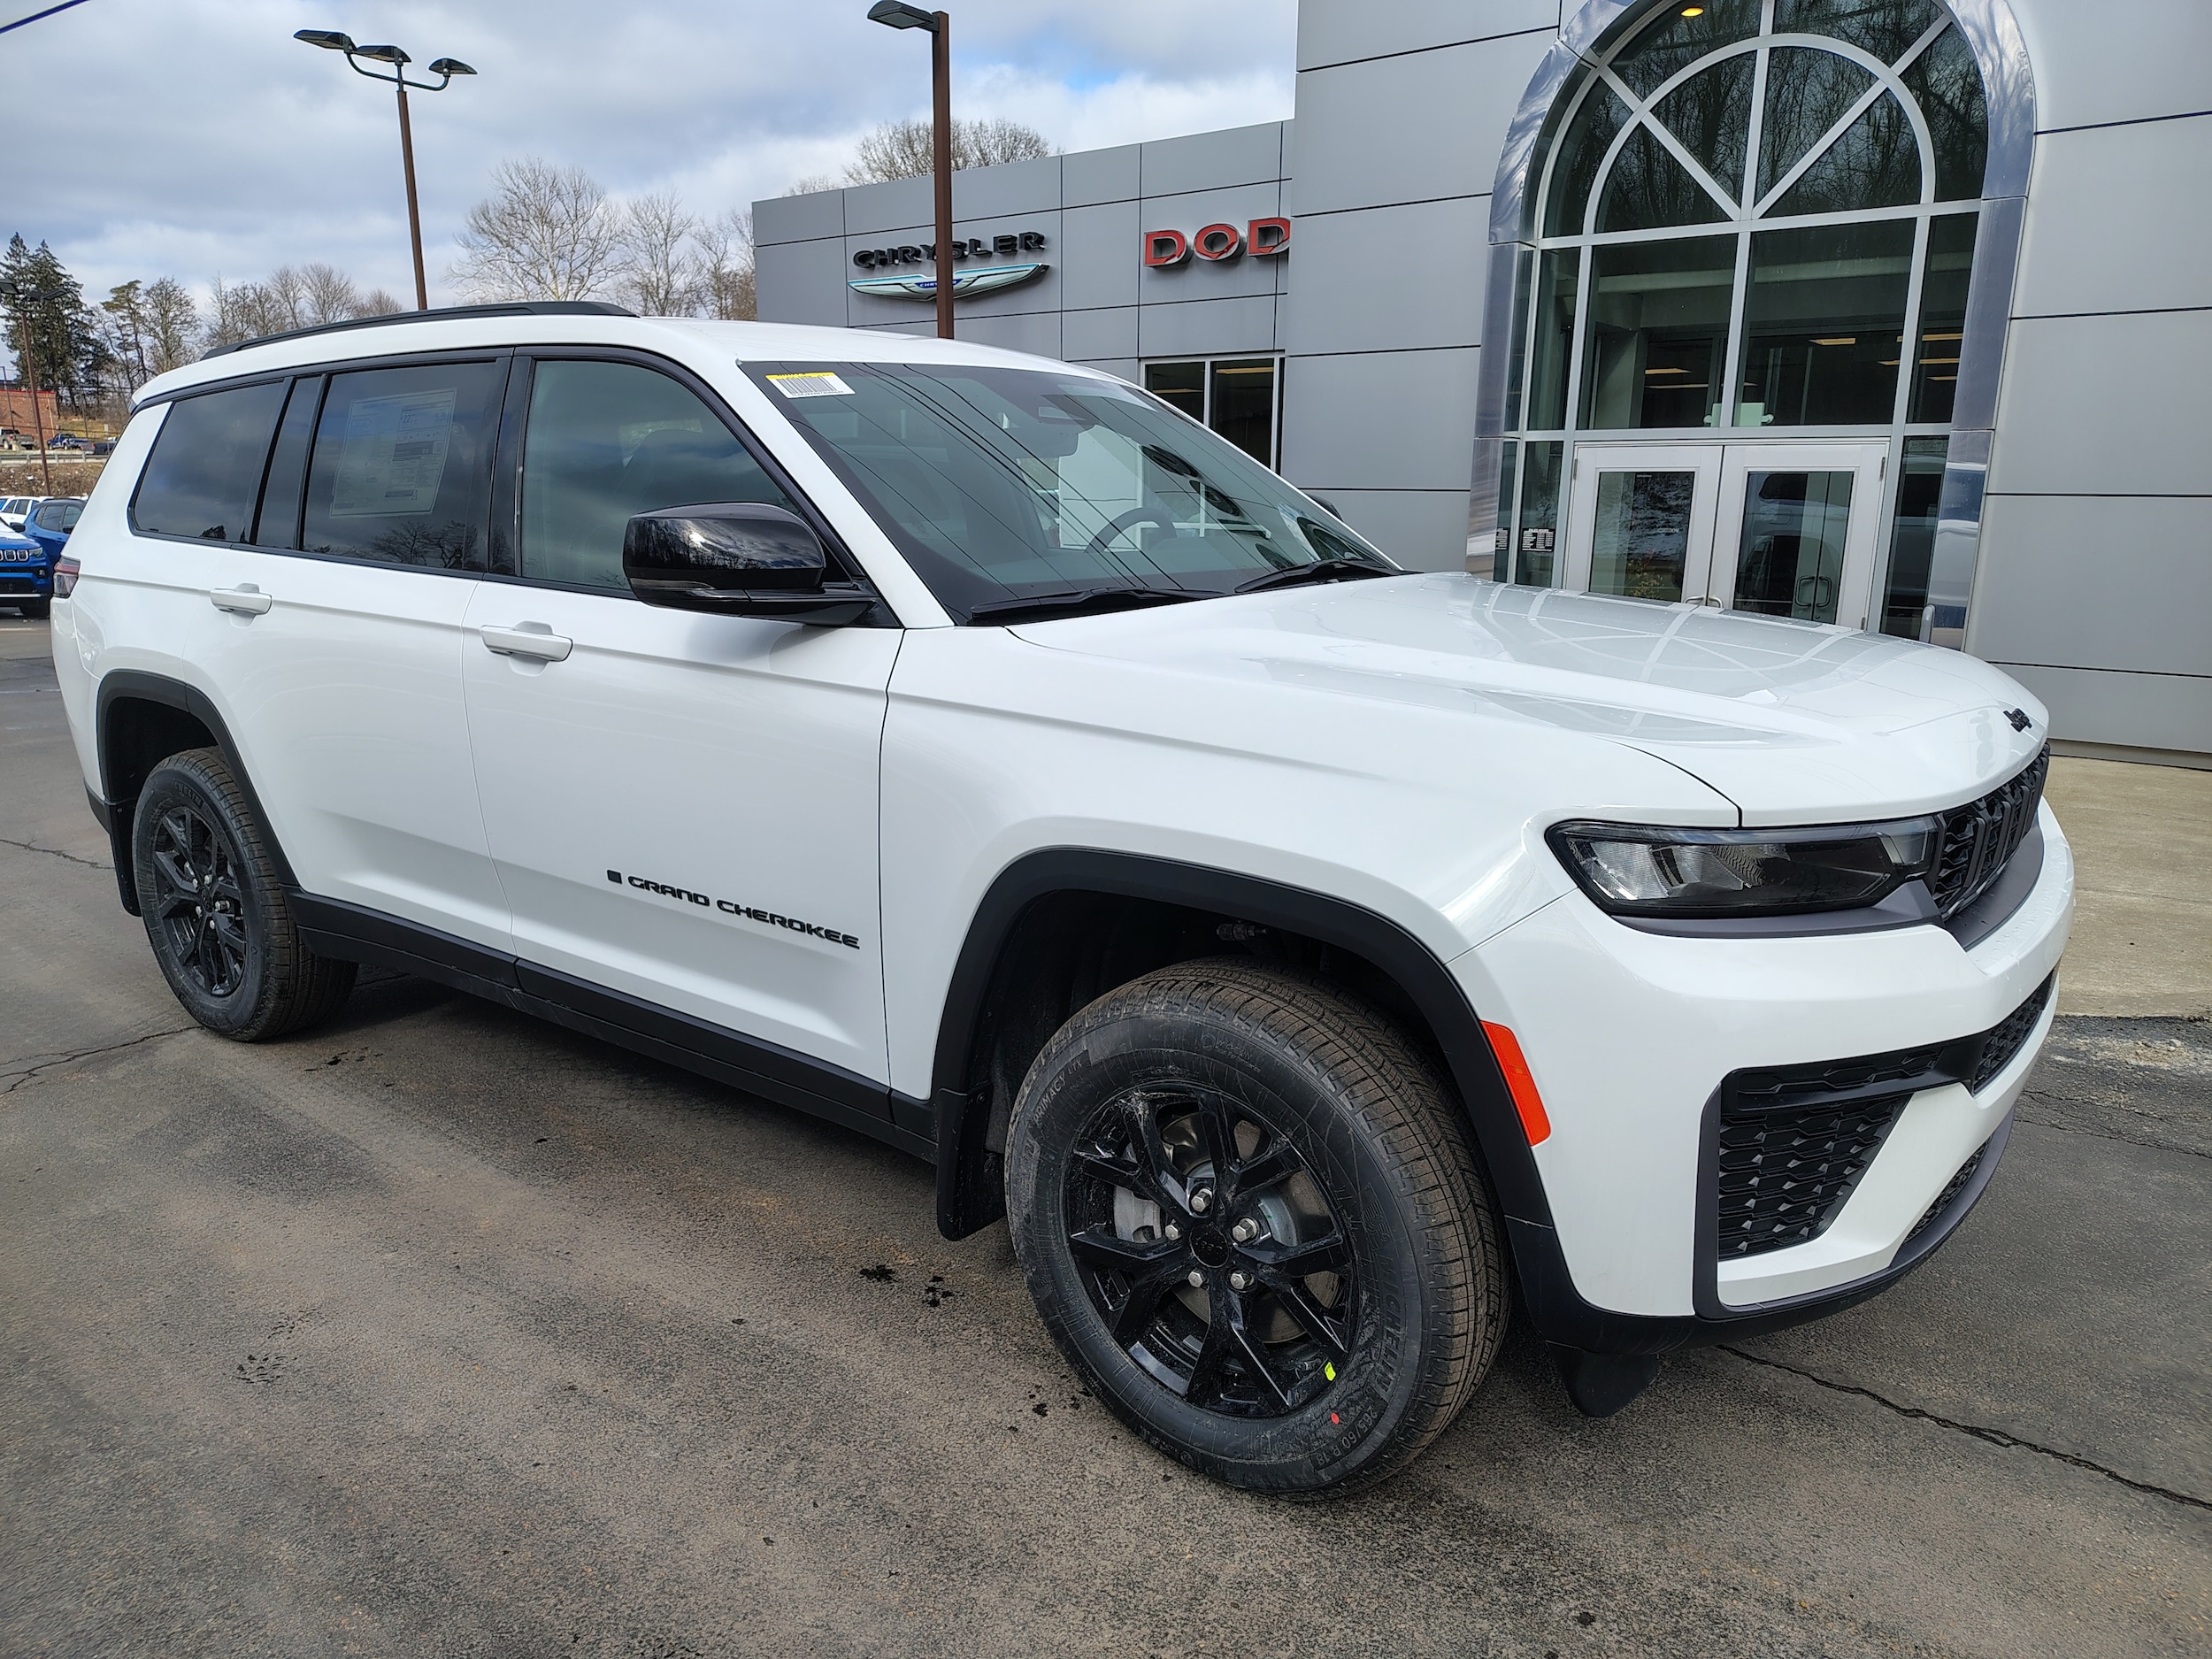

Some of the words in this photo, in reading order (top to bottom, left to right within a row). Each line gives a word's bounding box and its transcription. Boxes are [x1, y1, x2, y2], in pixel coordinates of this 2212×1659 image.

[627, 875, 710, 907] GRAND
[717, 899, 860, 949] CHEROKEE
[1033, 1071, 1066, 1127] PRIMACY
[1068, 1058, 1082, 1075] LTX
[1376, 1253, 1402, 1394] MICHELIN
[1341, 1405, 1378, 1449] 265/60
